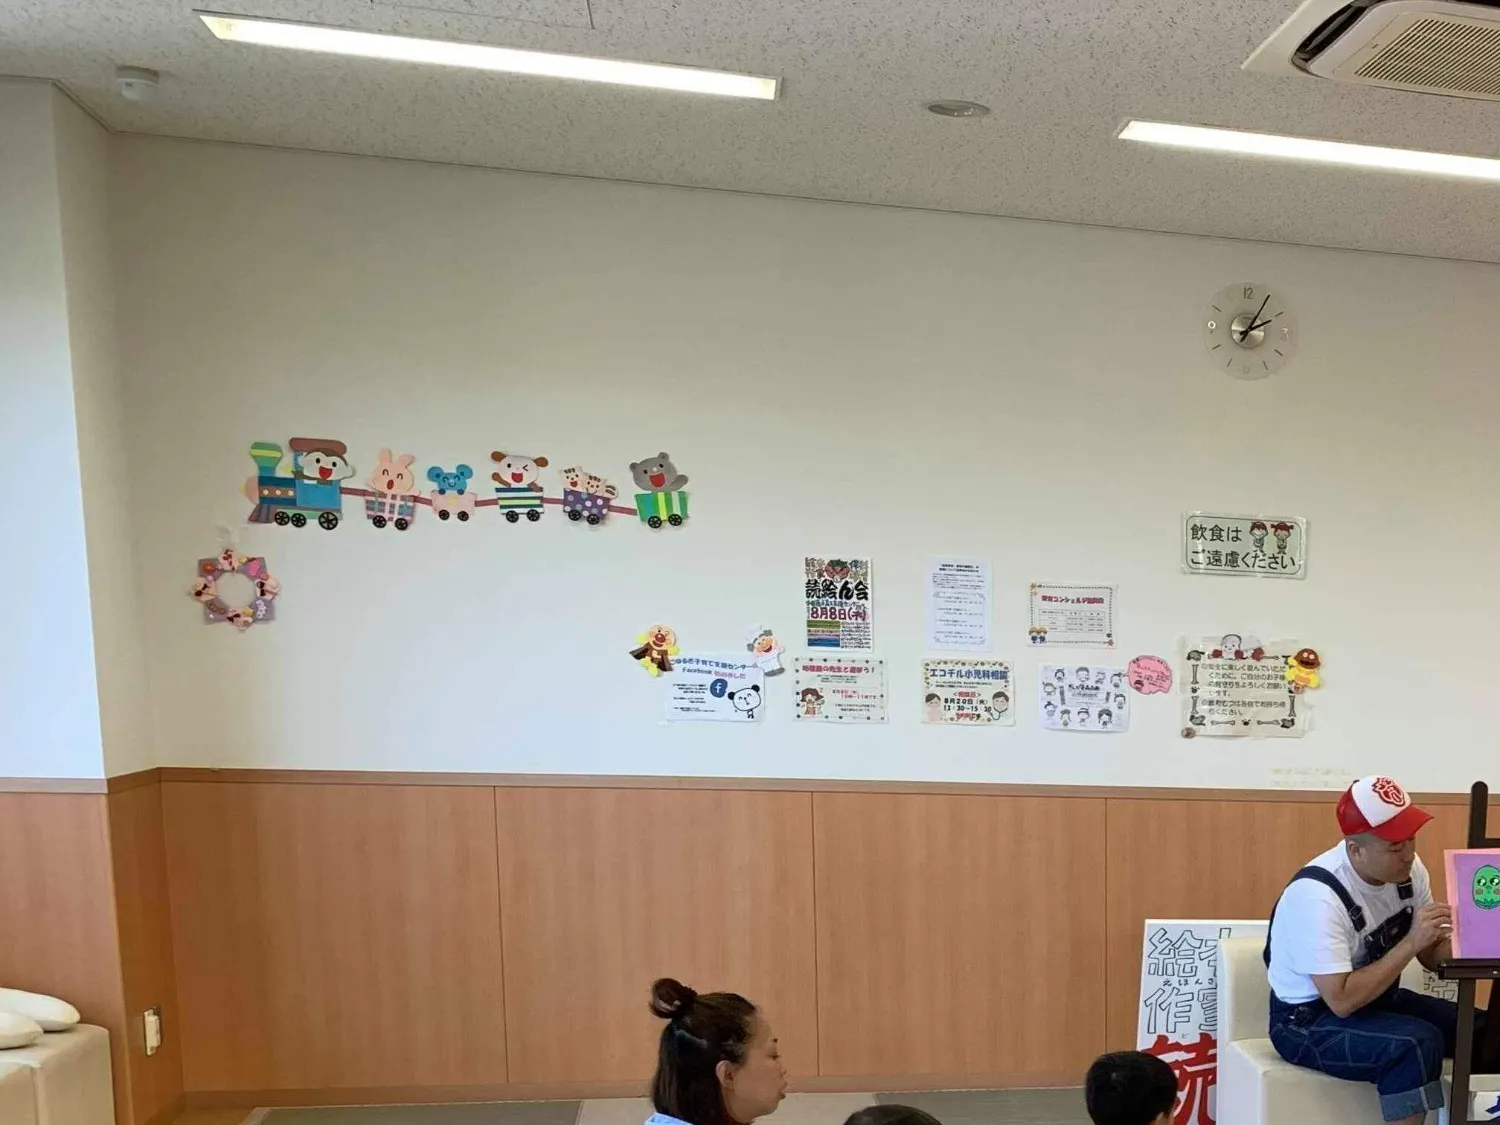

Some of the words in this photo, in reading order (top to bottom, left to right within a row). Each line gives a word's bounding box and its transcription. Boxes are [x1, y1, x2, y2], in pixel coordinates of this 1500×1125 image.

[1243, 287, 1254, 299] 12
[1190, 523, 1242, 542] 飲食は
[1190, 548, 1296, 570] ご遠慮ください
[805, 579, 869, 601] 読絵ん会
